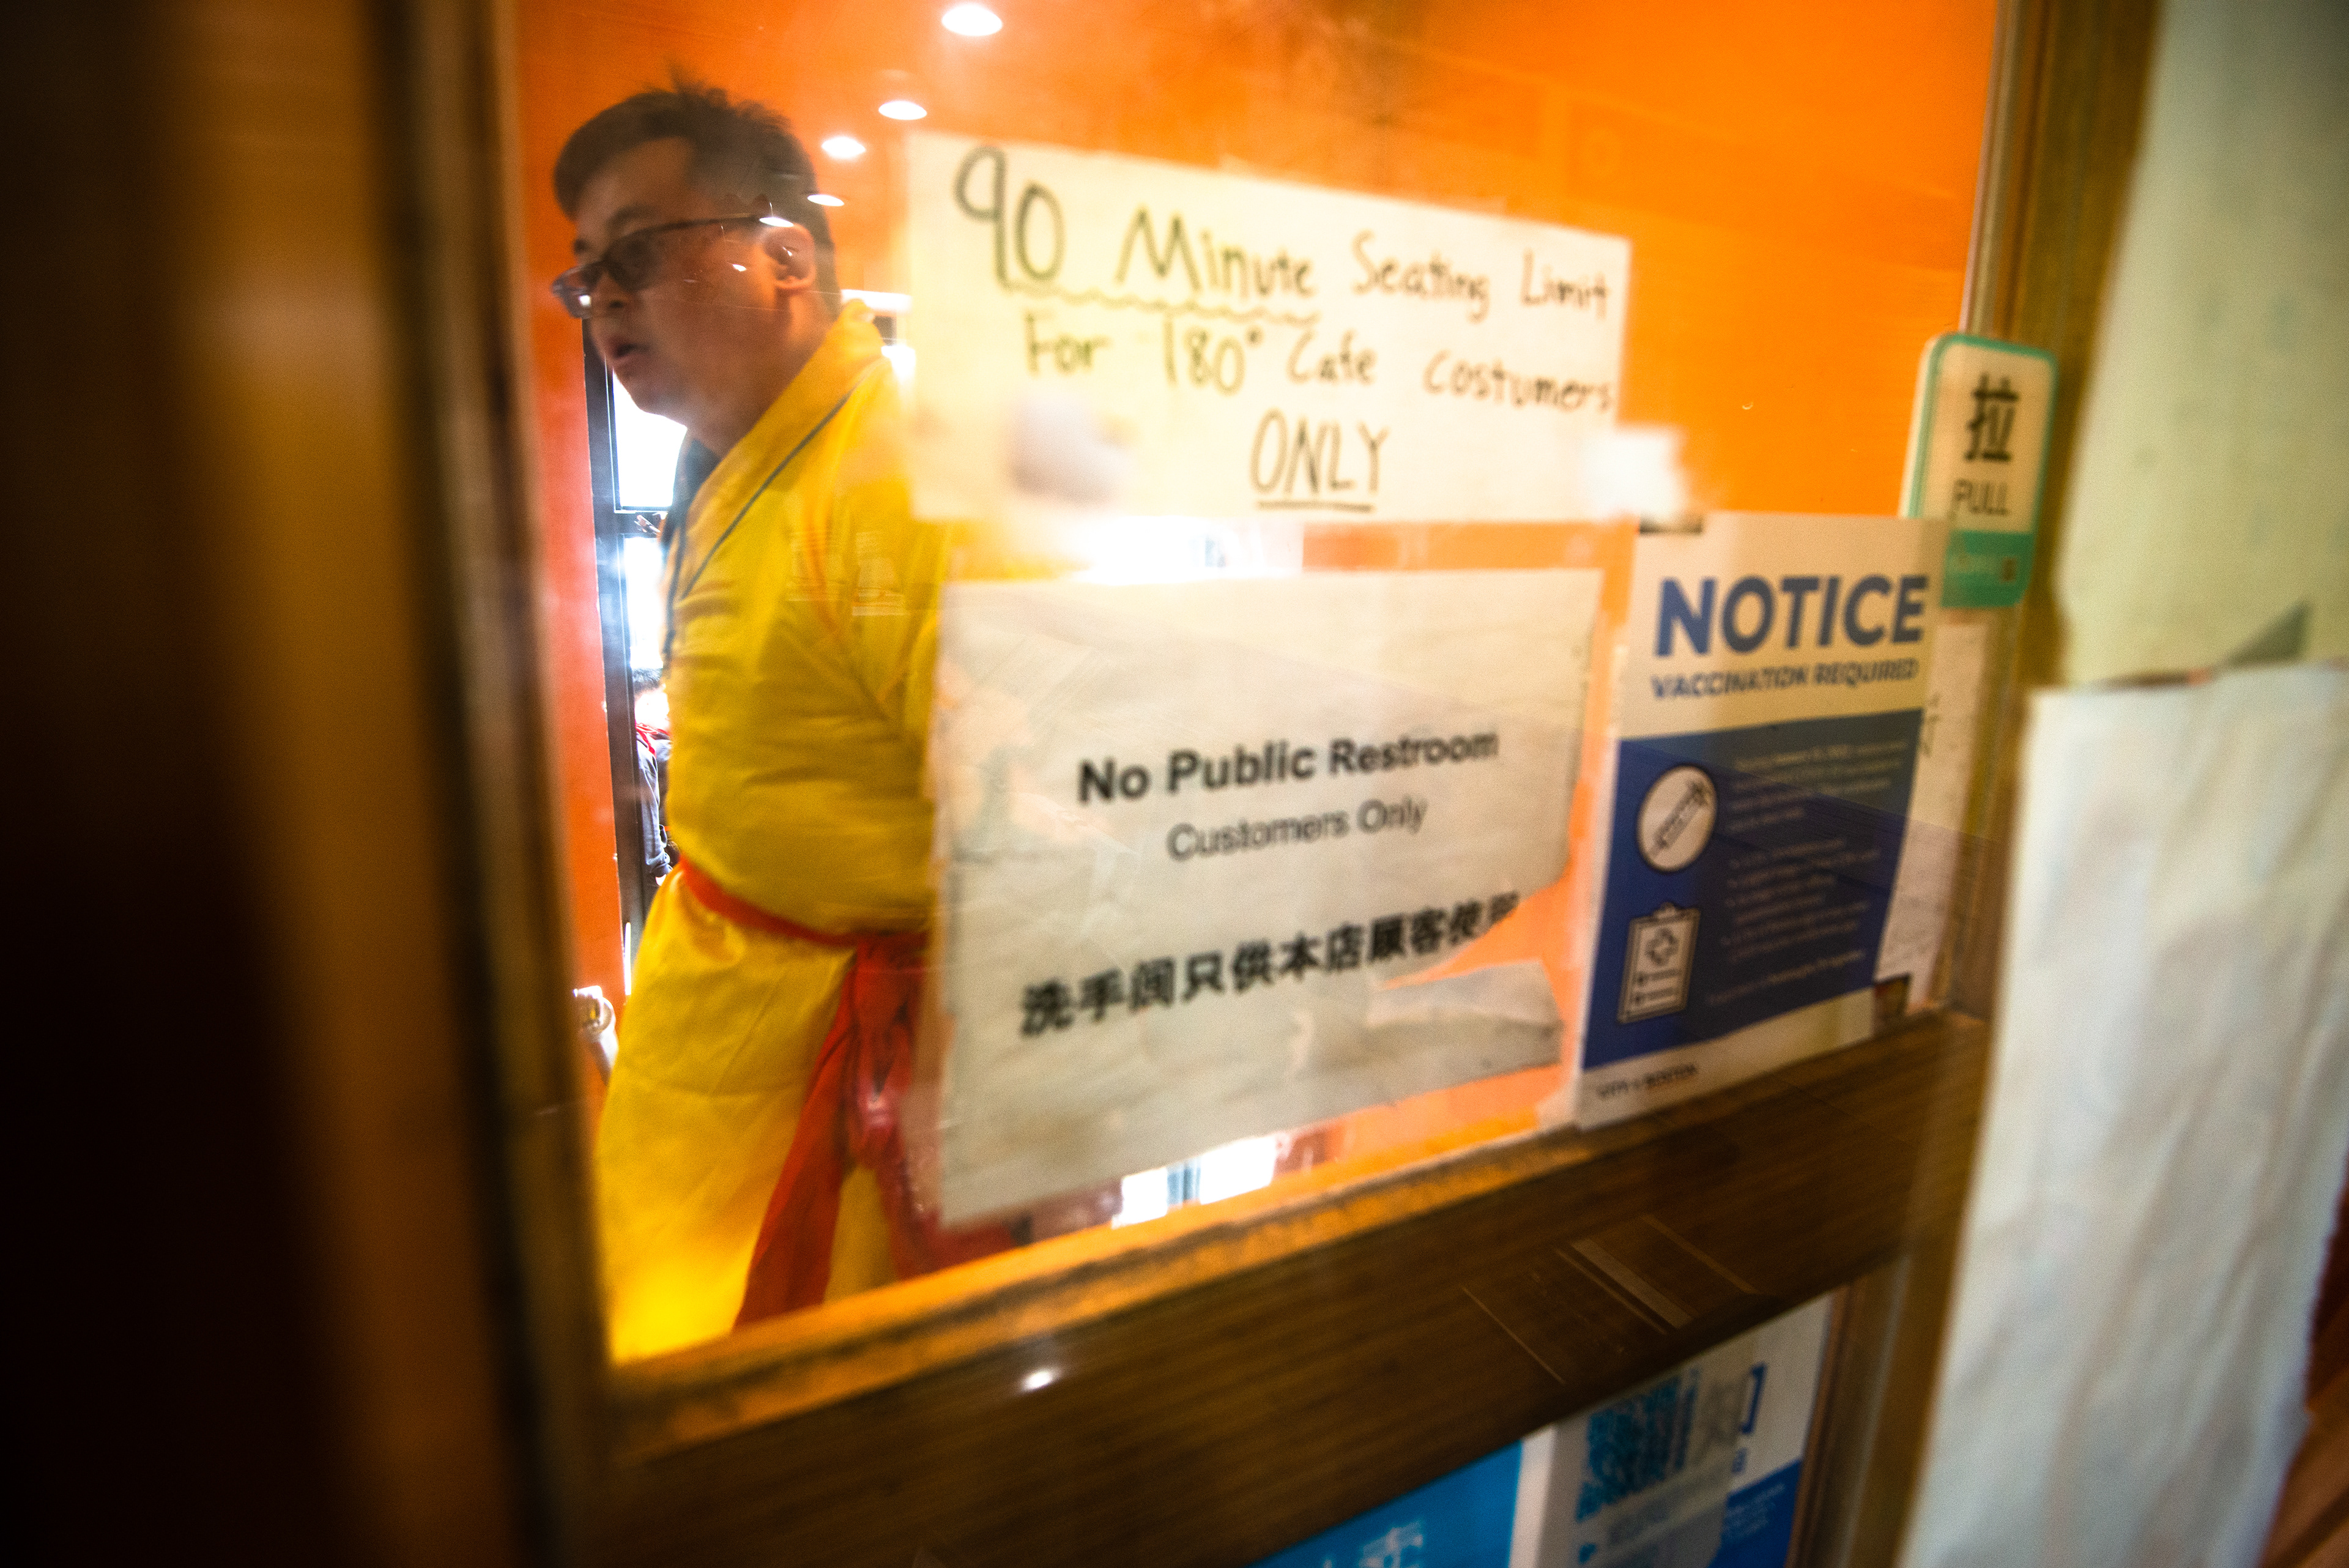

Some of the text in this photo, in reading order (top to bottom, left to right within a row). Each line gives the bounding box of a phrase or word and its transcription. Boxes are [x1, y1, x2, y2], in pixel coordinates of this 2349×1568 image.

[952, 146, 1610, 322] 90 Minute Seating Limit
[1024, 310, 1111, 376] For
[1286, 328, 1376, 385] Cafe
[1250, 408, 1390, 497] ONLY
[1964, 372, 2020, 462] 拉
[1951, 478, 2010, 517] PULL
[1654, 574, 1930, 658] NOTICE
[1652, 657, 1920, 698] VACCINATION REQUIRED
[1078, 730, 1499, 803] No Public Restroom
[1167, 793, 1428, 861] Customers Only
